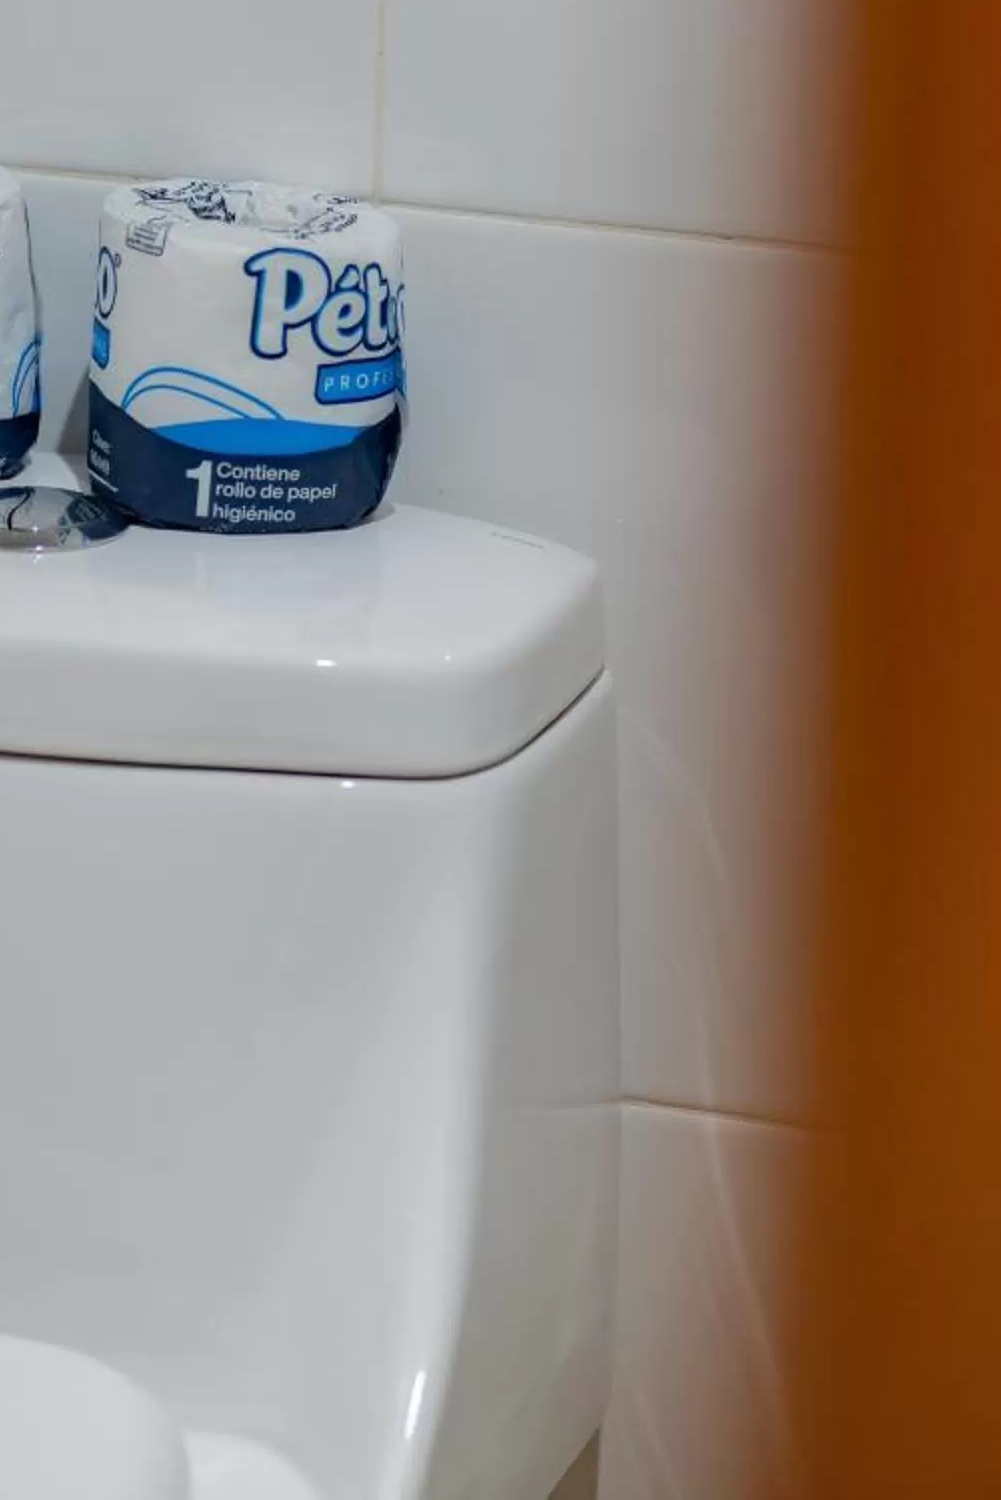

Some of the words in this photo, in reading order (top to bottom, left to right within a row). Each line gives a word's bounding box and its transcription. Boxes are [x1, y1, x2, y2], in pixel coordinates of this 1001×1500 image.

[216, 461, 301, 481] Contiene
[185, 459, 213, 518] 1
[215, 482, 256, 498] rollo
[260, 484, 284, 499] de
[287, 483, 338, 503] papel
[212, 503, 296, 523] higiénico
